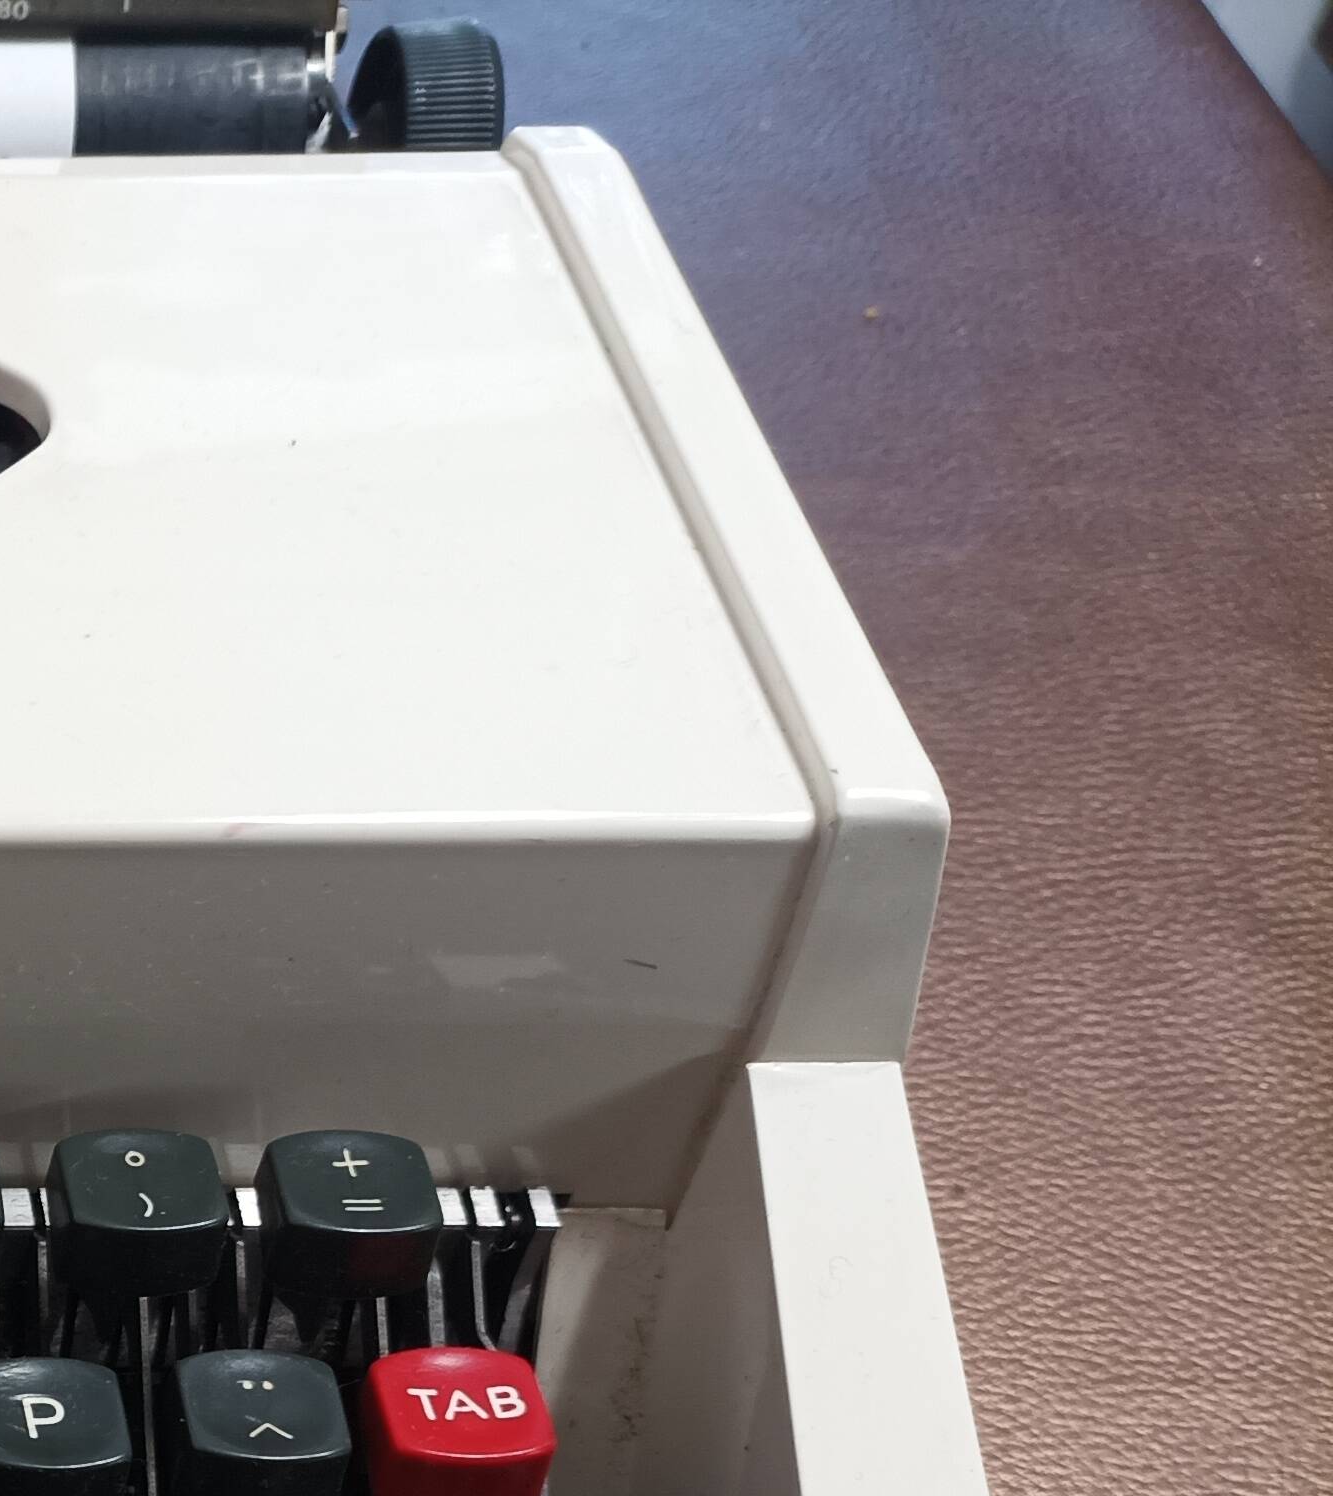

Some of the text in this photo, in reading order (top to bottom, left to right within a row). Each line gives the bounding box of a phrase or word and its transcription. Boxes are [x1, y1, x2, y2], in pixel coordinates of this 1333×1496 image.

[331, 1147, 370, 1179] +
[341, 1197, 385, 1213] =
[19, 1394, 66, 1440] P
[405, 1384, 527, 1422] TAB
